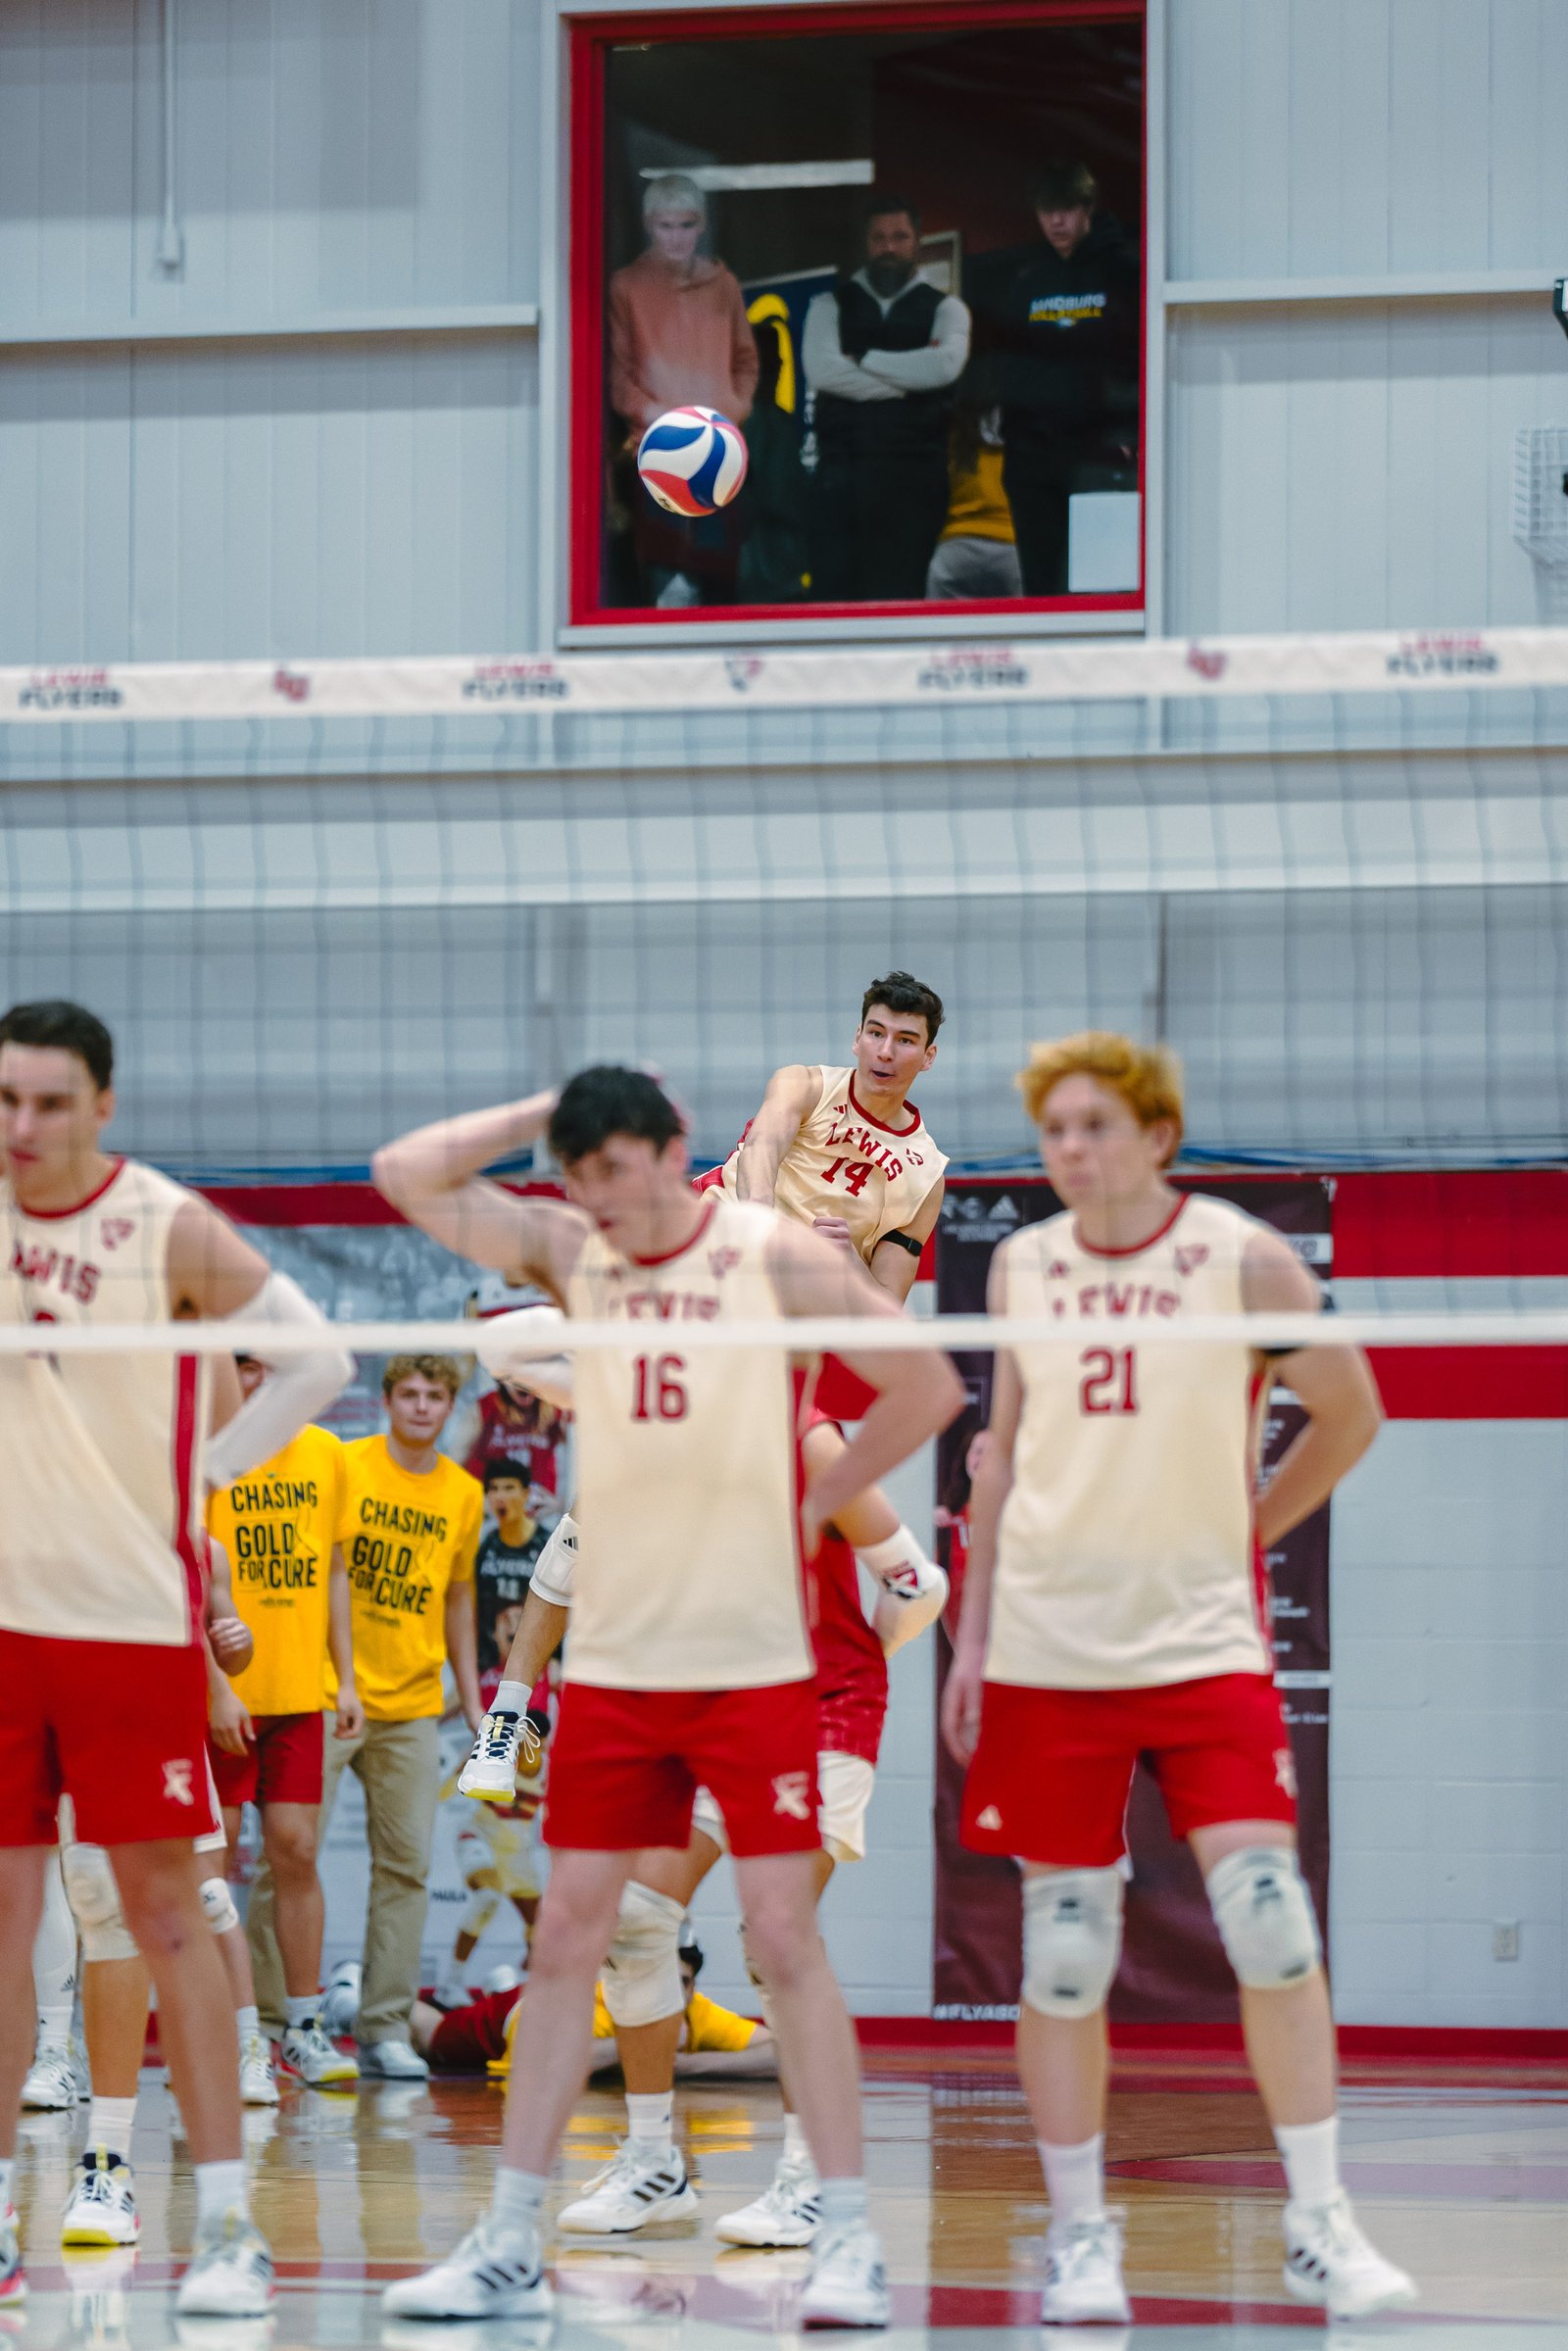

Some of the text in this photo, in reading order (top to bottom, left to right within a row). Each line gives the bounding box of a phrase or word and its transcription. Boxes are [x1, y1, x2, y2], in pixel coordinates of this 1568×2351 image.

[825, 1123, 903, 1181] LEWIS
[821, 1157, 874, 1198] 14
[630, 1353, 689, 1423] 16
[1079, 1346, 1139, 1416] 21
[230, 1481, 318, 1512] CHASING
[236, 1523, 293, 1558] GOLD
[360, 1497, 447, 1542] CHASING
[238, 1560, 264, 1581] FOR
[270, 1557, 318, 1589] CURE
[353, 1536, 412, 1577] GOLD
[348, 1566, 431, 1615] FOR CURE
